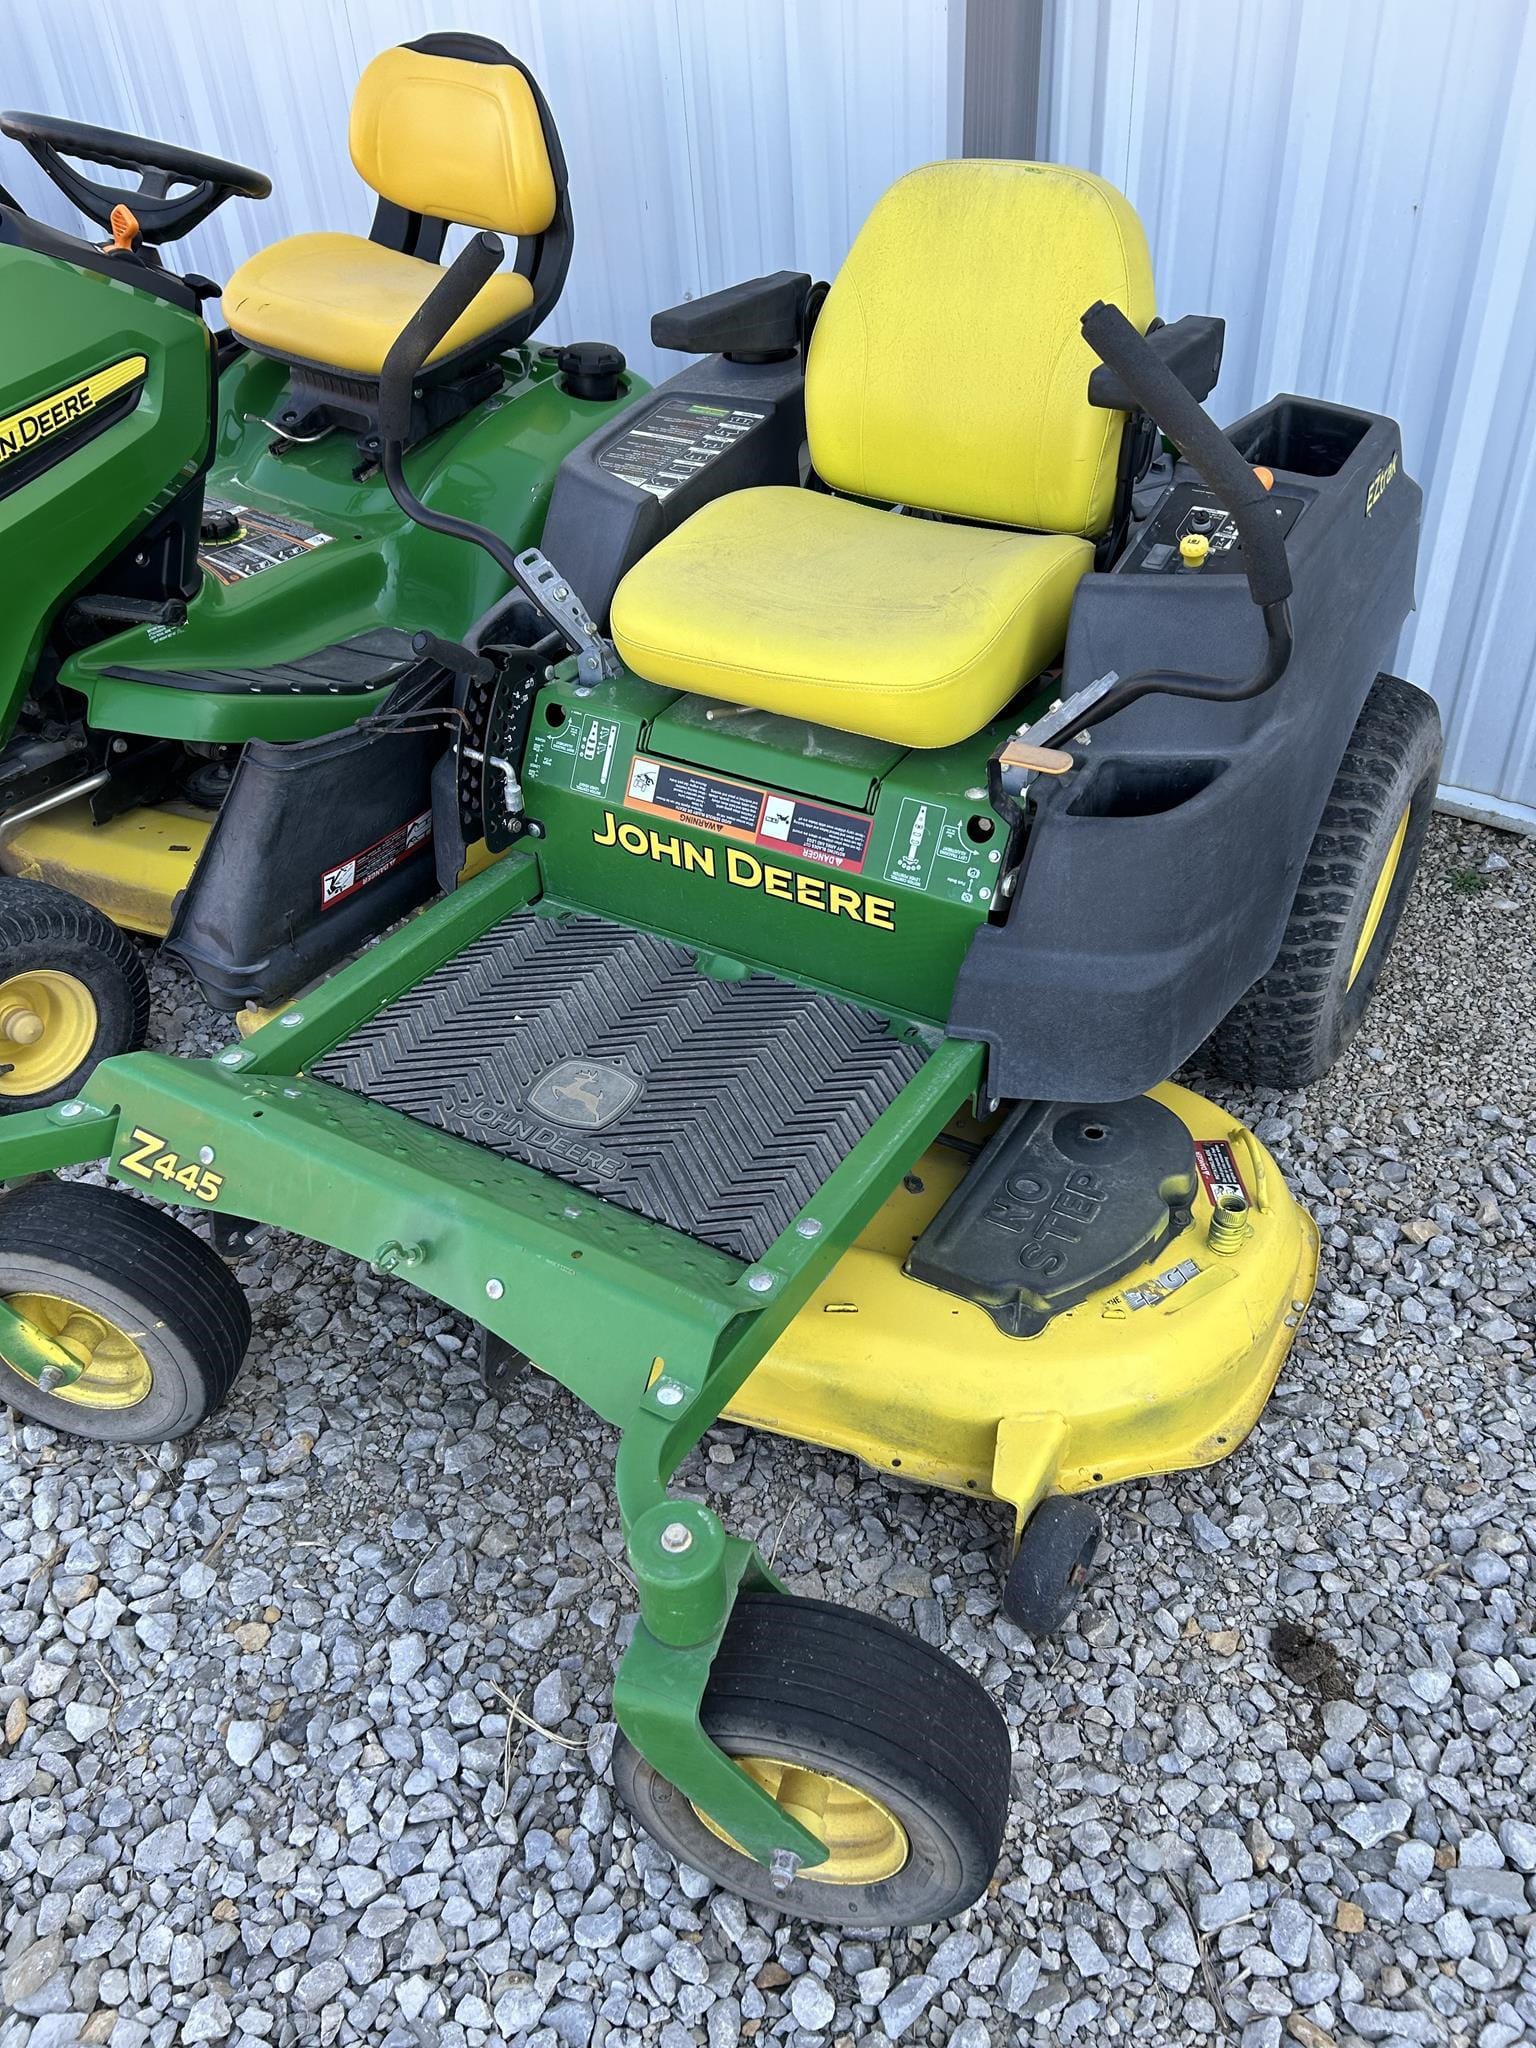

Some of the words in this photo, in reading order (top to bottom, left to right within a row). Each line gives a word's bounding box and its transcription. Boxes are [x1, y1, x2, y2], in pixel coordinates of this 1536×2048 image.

[18, 387, 95, 445] DEERE
[679, 813, 716, 830] WARNING
[592, 809, 716, 878] JOHN
[725, 846, 896, 932] DEERE
[801, 848, 834, 864] DANGER
[118, 1125, 225, 1203] Z445
[456, 1102, 537, 1142] JOHN
[527, 1127, 626, 1178] DEERE
[1195, 1151, 1208, 1171] DANGER
[984, 1172, 1051, 1233] NO
[1018, 1168, 1109, 1277] STEP
[1106, 1295, 1122, 1306] THE
